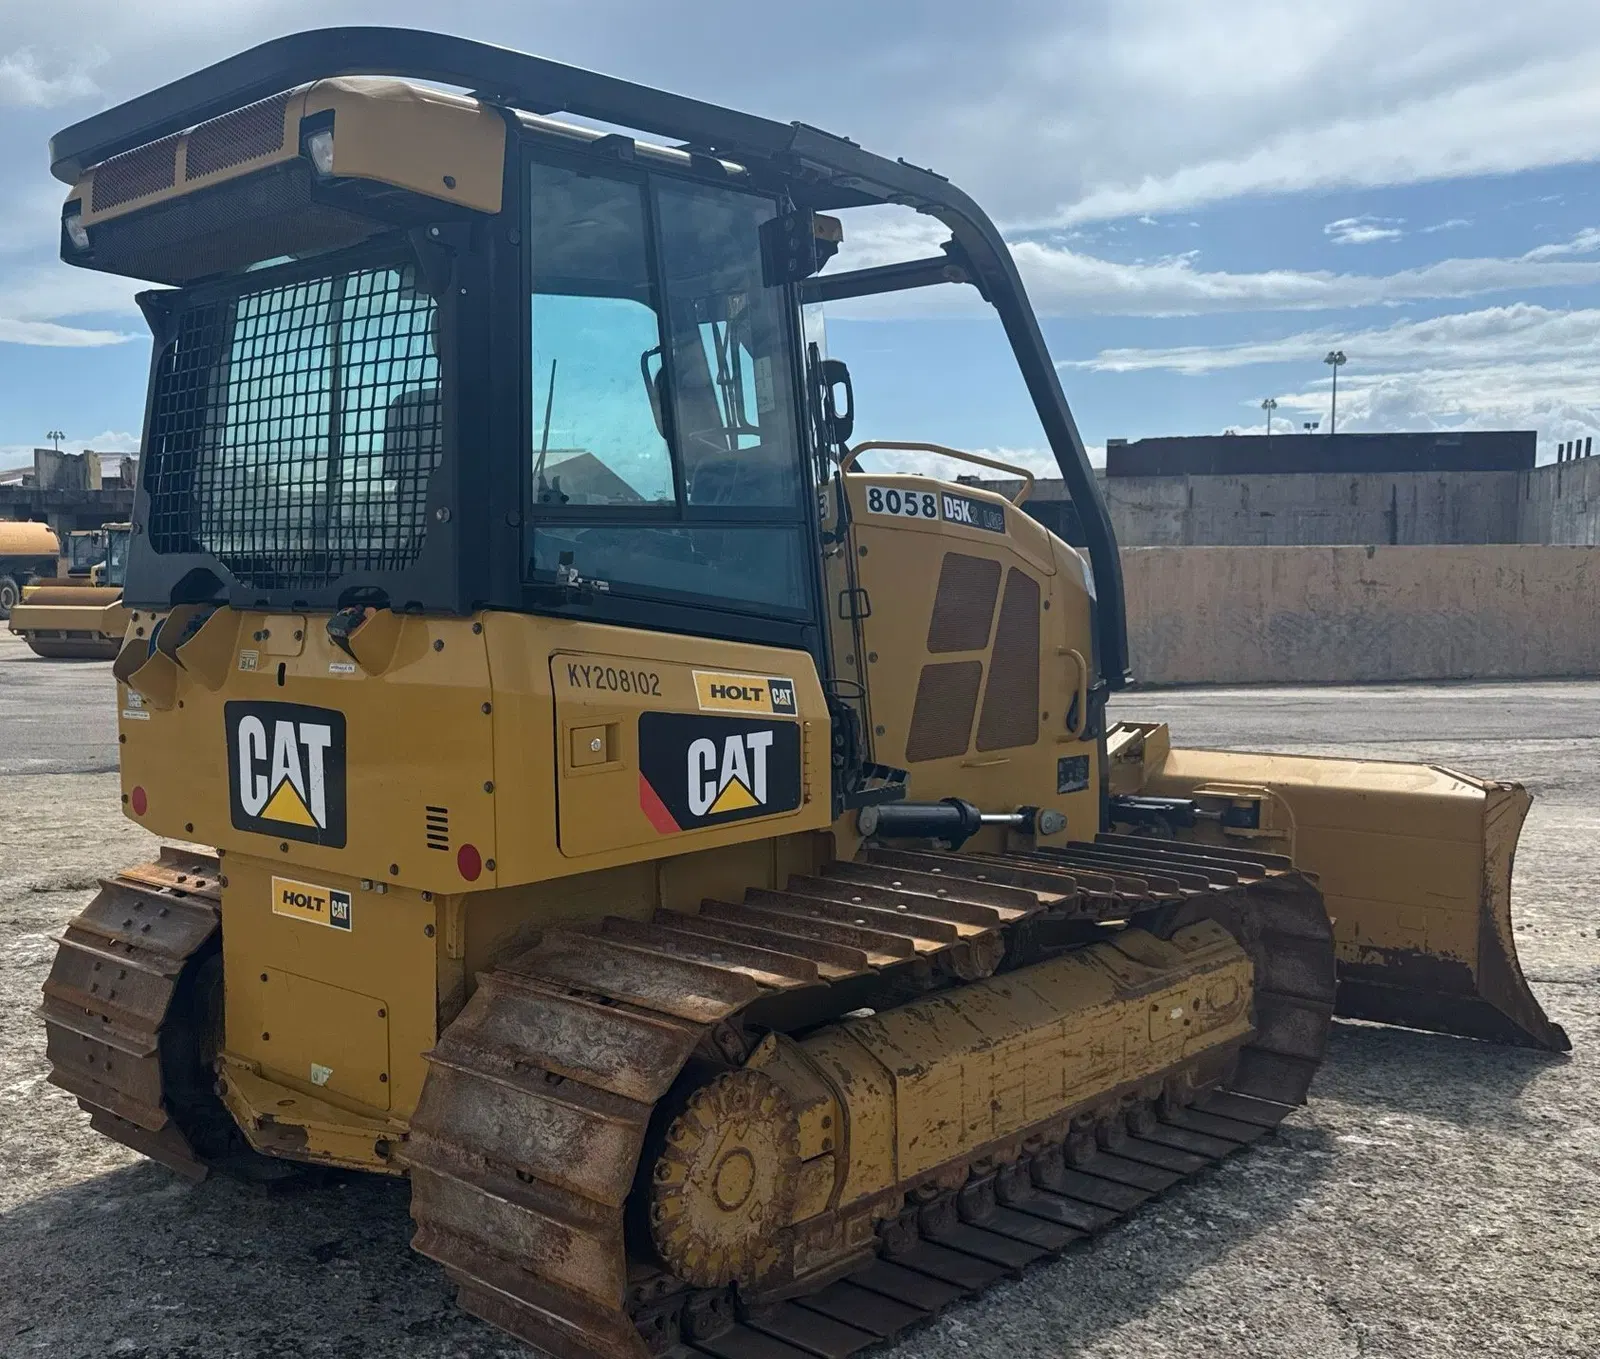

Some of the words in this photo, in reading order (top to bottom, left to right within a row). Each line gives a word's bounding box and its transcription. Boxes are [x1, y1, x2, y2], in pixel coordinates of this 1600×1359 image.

[868, 488, 937, 518] 8058
[567, 663, 662, 697] KY208102
[710, 684, 764, 702] HOLT
[771, 688, 791, 706] CAT
[238, 715, 331, 829] CAT
[687, 730, 773, 816] CAT
[282, 890, 326, 912] HOLT
[331, 900, 348, 919] CAT
